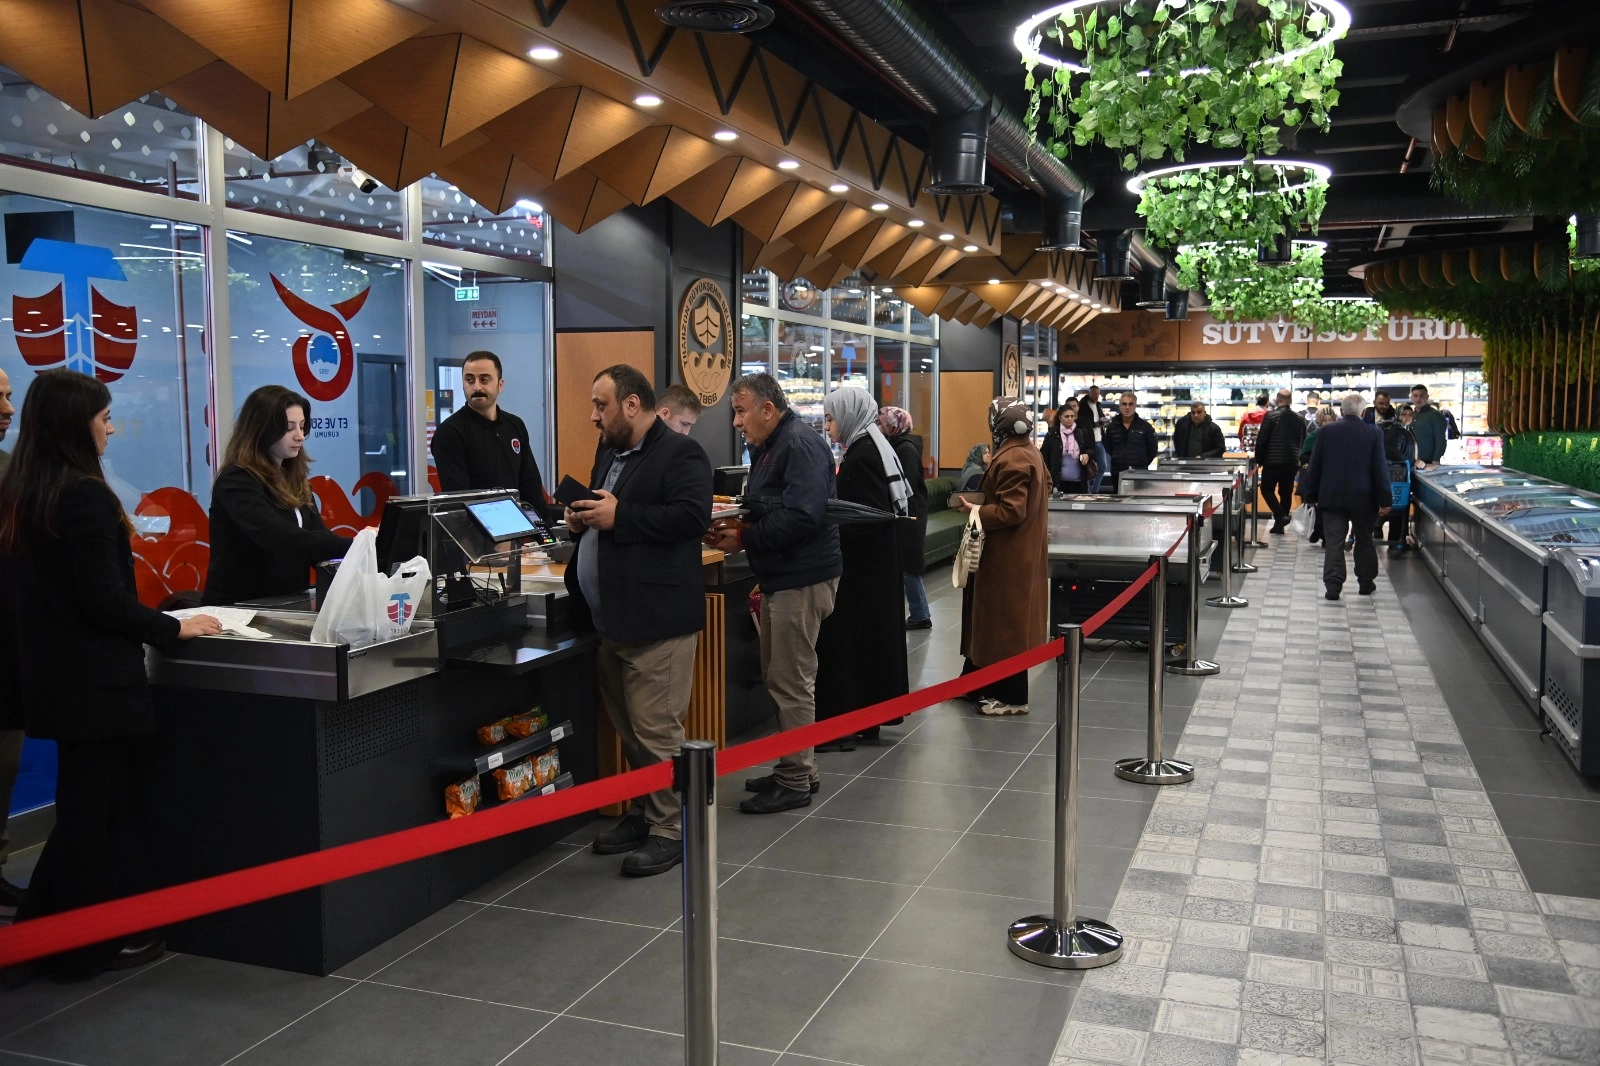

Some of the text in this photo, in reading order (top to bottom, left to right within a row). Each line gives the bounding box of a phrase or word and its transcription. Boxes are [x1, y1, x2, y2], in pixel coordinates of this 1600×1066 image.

[472, 310, 497, 319] MEYDAN
[1267, 321, 1313, 343] VE
[699, 392, 718, 405] 1868
